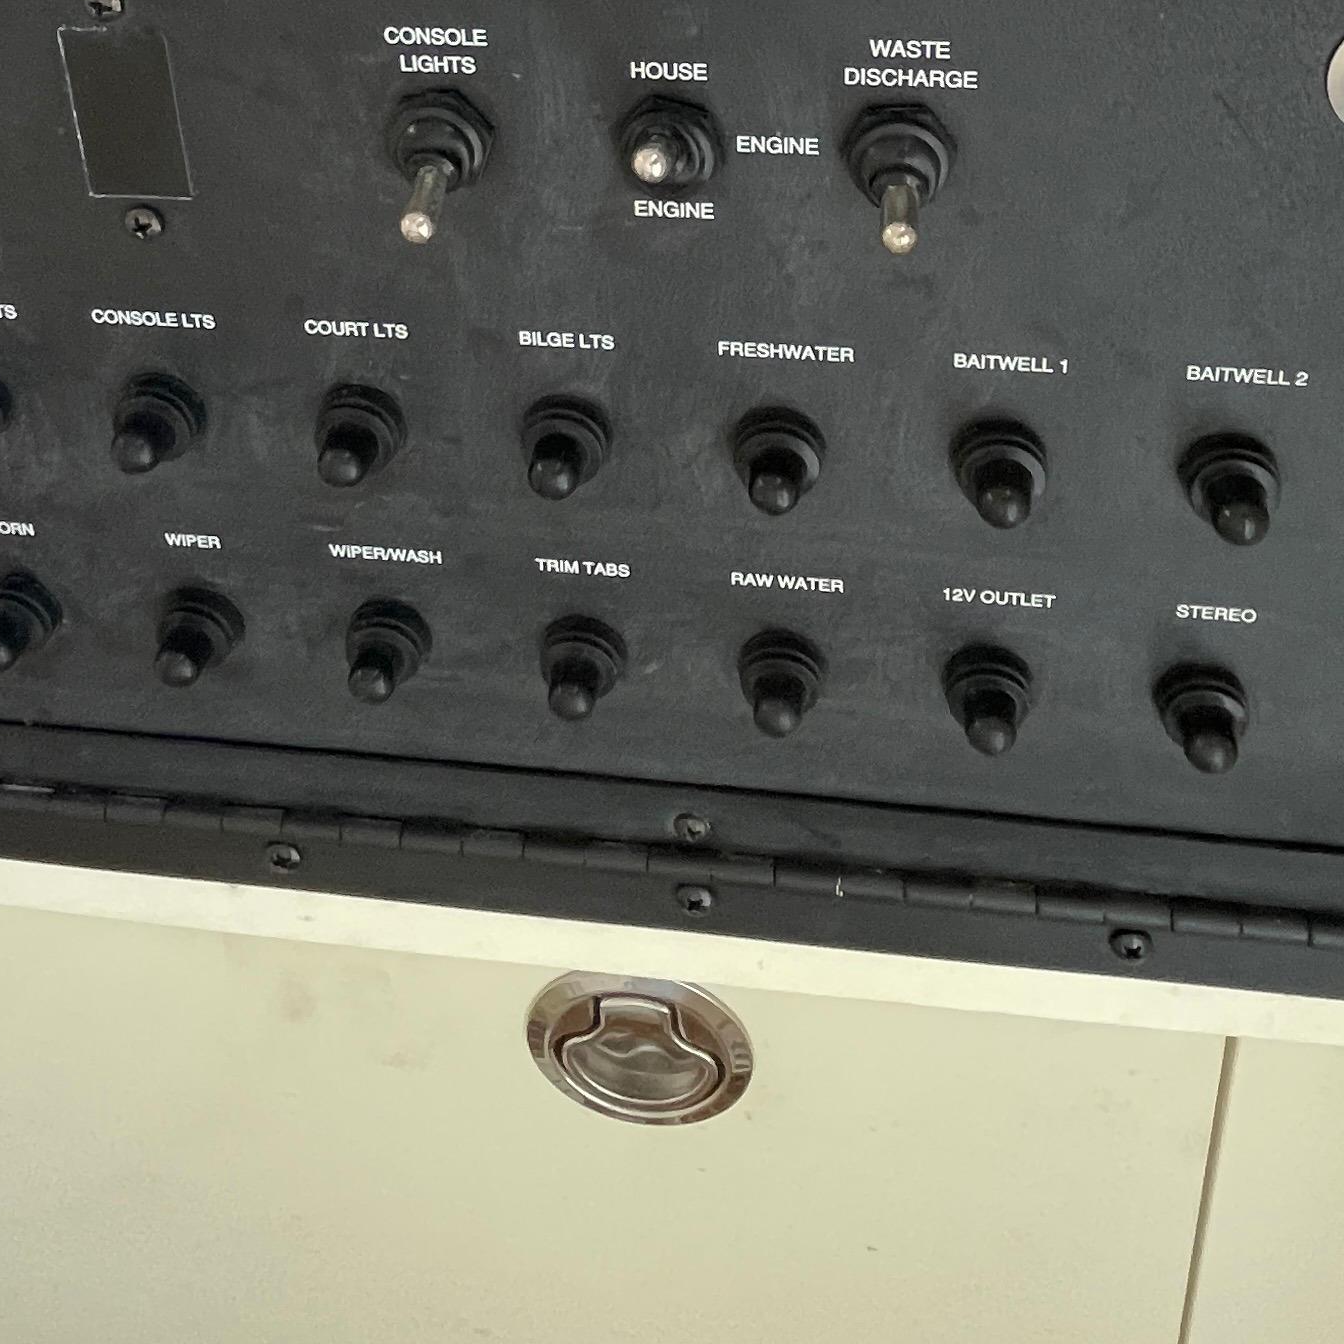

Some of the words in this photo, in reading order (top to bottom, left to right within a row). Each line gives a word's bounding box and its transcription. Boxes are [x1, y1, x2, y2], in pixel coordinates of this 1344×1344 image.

[384, 27, 488, 46] CONSOLE
[870, 39, 950, 59] WASTE
[400, 55, 476, 74] LIGHTS
[630, 62, 707, 80] HOUSE
[845, 68, 978, 88] DISCHARGE
[737, 136, 819, 155] ENGINE
[634, 200, 714, 219] ENGINE
[91, 309, 178, 327] CONSOLE
[181, 314, 215, 329] LTS
[304, 320, 369, 336] COURT
[373, 323, 408, 339] LTS
[519, 331, 574, 347] BILGE
[579, 334, 614, 349] LTS
[718, 341, 854, 362] FRESHWATER
[954, 353, 1053, 373] BAITWELL
[1060, 359, 1067, 373] 1
[1187, 365, 1290, 385] BAITWELL
[1295, 372, 1308, 386] 2
[165, 533, 221, 548] WIPER
[329, 544, 442, 564] WIPER/WASH
[535, 558, 579, 574] TRIM
[582, 562, 630, 577] TABS
[731, 572, 773, 587] RAW
[778, 575, 843, 593] WATER
[943, 588, 975, 602] 12V
[980, 591, 1056, 608] OUTLET
[1176, 605, 1256, 623] STEREO
